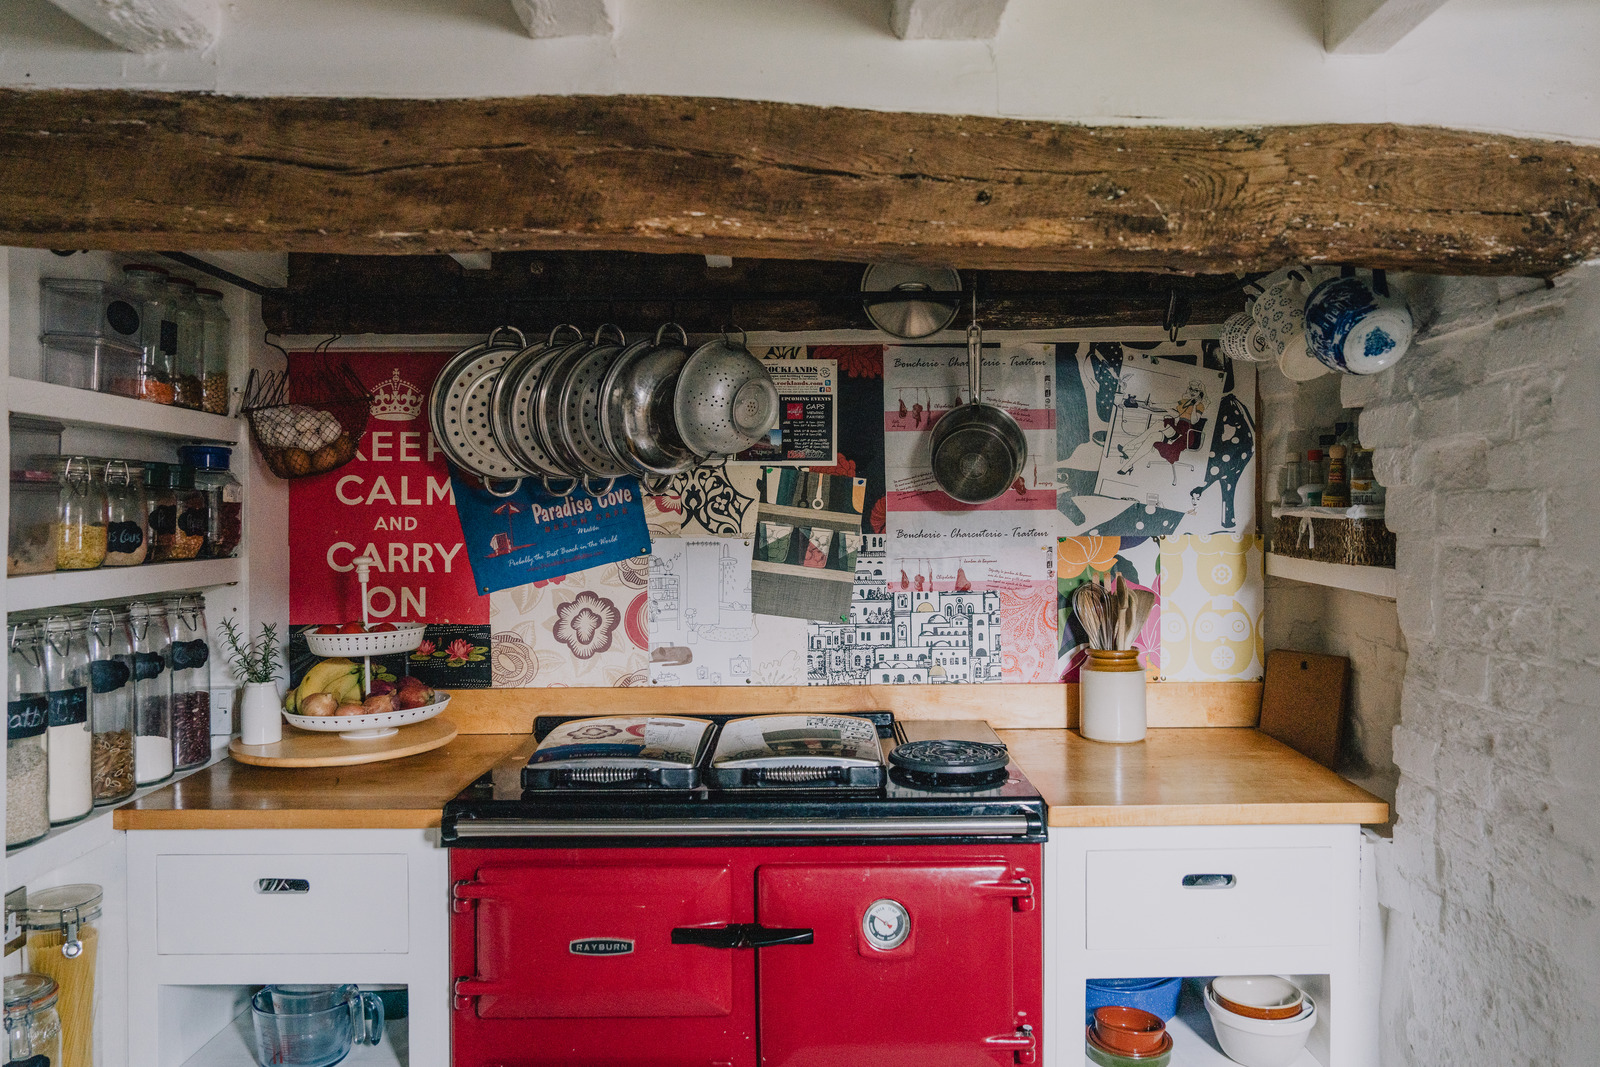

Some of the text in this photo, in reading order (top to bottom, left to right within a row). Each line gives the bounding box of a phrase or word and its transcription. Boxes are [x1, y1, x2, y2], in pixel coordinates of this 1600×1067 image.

[894, 358, 940, 368] Boucherie
[1010, 356, 1046, 366] Traiteur
[335, 475, 456, 506] CALM
[532, 488, 633, 524] Paradise Cove
[374, 516, 418, 531] AND
[896, 528, 941, 539] Boucherie
[950, 527, 1002, 539] Charcuterie
[1012, 527, 1048, 538] Traiteur
[326, 542, 464, 573] CARRY
[508, 554, 534, 567] Probably
[534, 552, 544, 561] the
[546, 550, 559, 558] Best
[561, 544, 579, 555] Beach
[588, 540, 597, 548] the
[599, 535, 618, 545] World
[366, 586, 426, 618] ON
